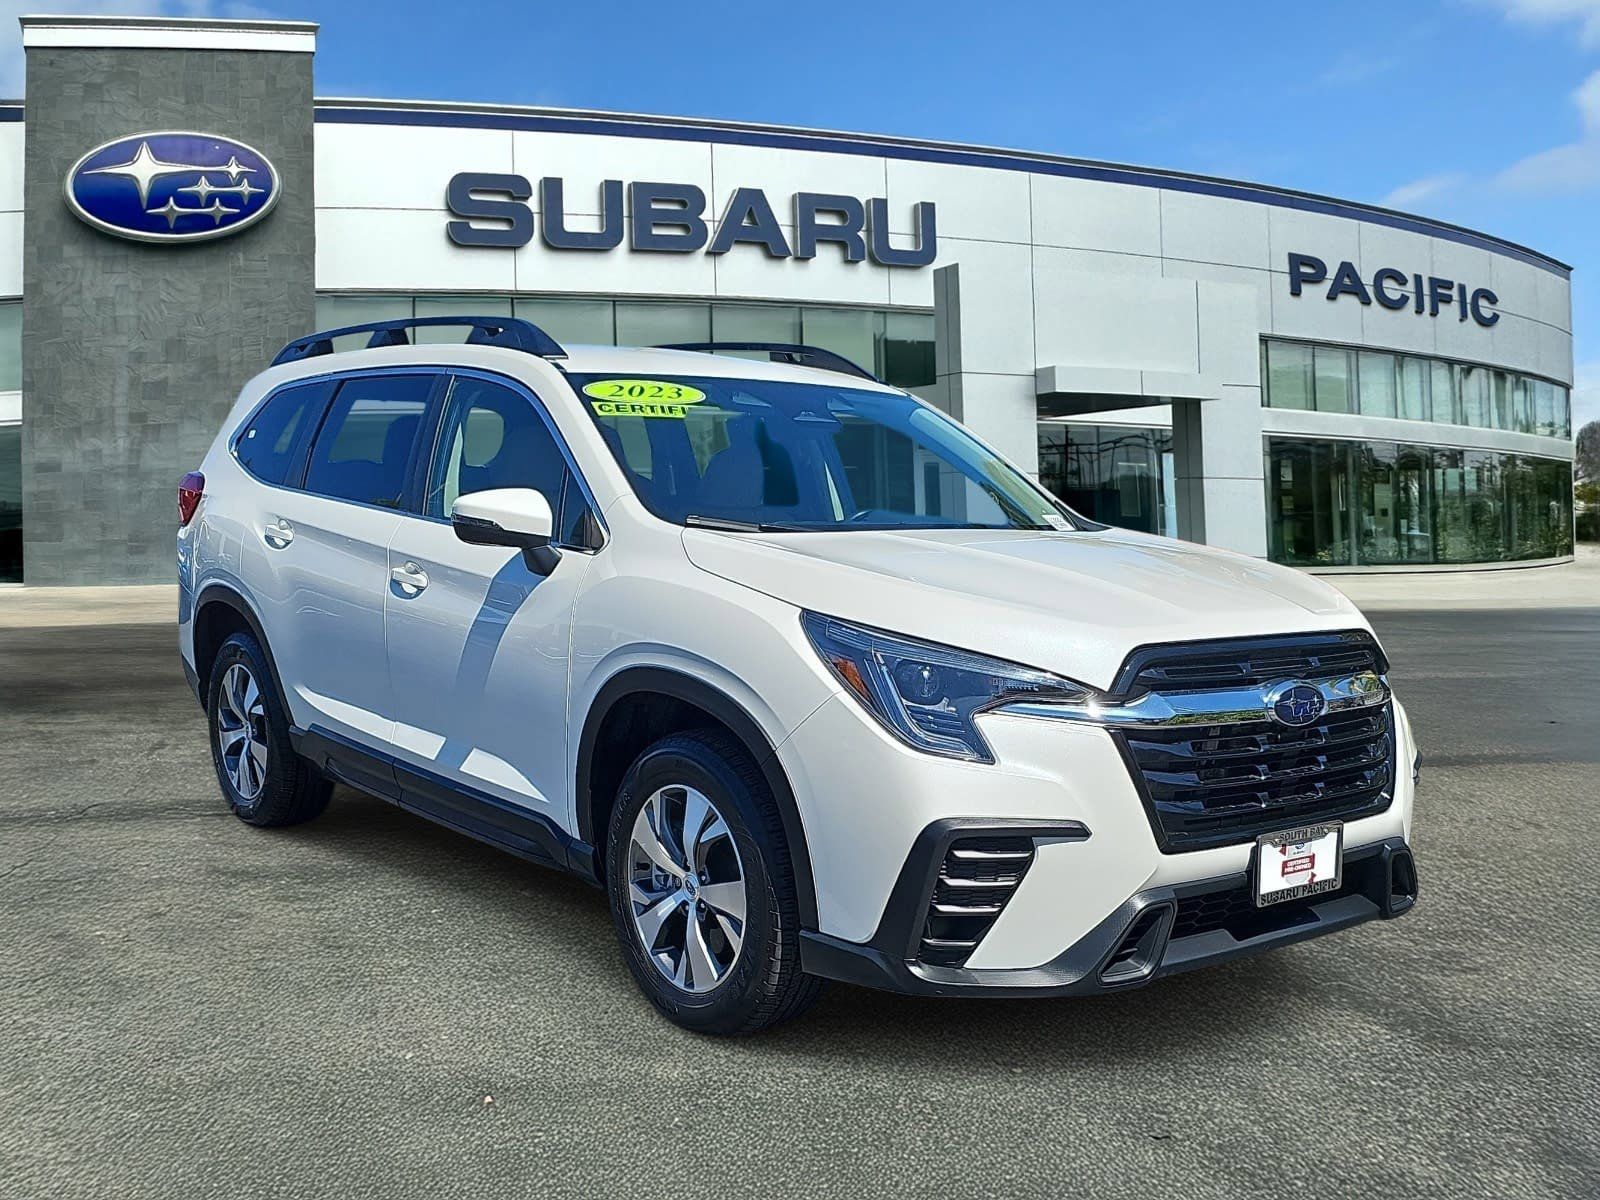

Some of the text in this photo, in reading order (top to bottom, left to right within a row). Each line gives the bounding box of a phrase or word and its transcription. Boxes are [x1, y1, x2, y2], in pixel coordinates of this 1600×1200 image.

[447, 171, 937, 267] SUBARU
[1288, 252, 1500, 327] PACIFIC
[608, 384, 682, 399] 2023
[1279, 826, 1326, 841] SOUTH BAY
[1260, 879, 1338, 905] SUBARU PACIFIC
